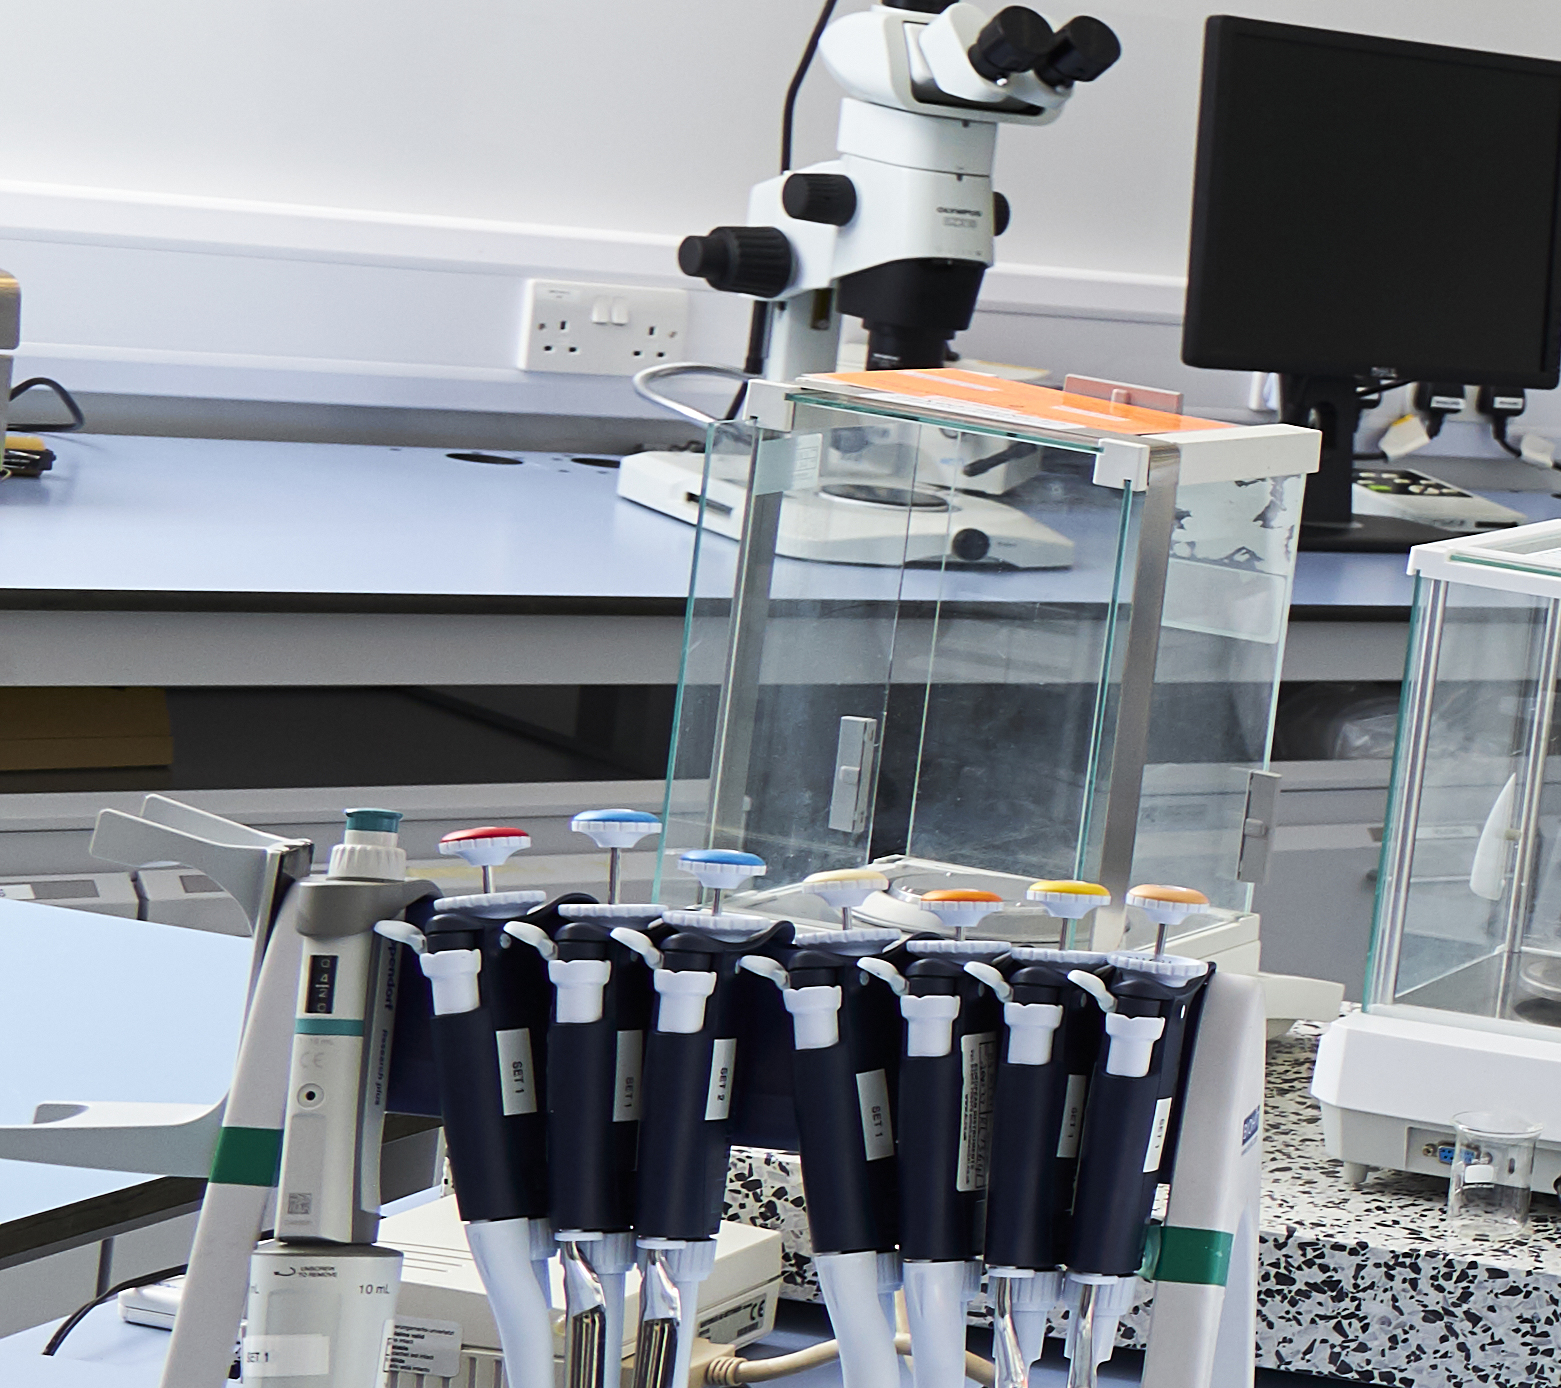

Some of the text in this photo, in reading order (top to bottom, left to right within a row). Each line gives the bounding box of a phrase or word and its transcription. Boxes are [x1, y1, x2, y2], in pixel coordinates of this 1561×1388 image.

[384, 938, 398, 1011] ppendorf
[512, 1061, 523, 1086] SET
[624, 1076, 634, 1099] SET
[872, 1106, 882, 1128] SET
[359, 1284, 390, 1294] 10 mL
